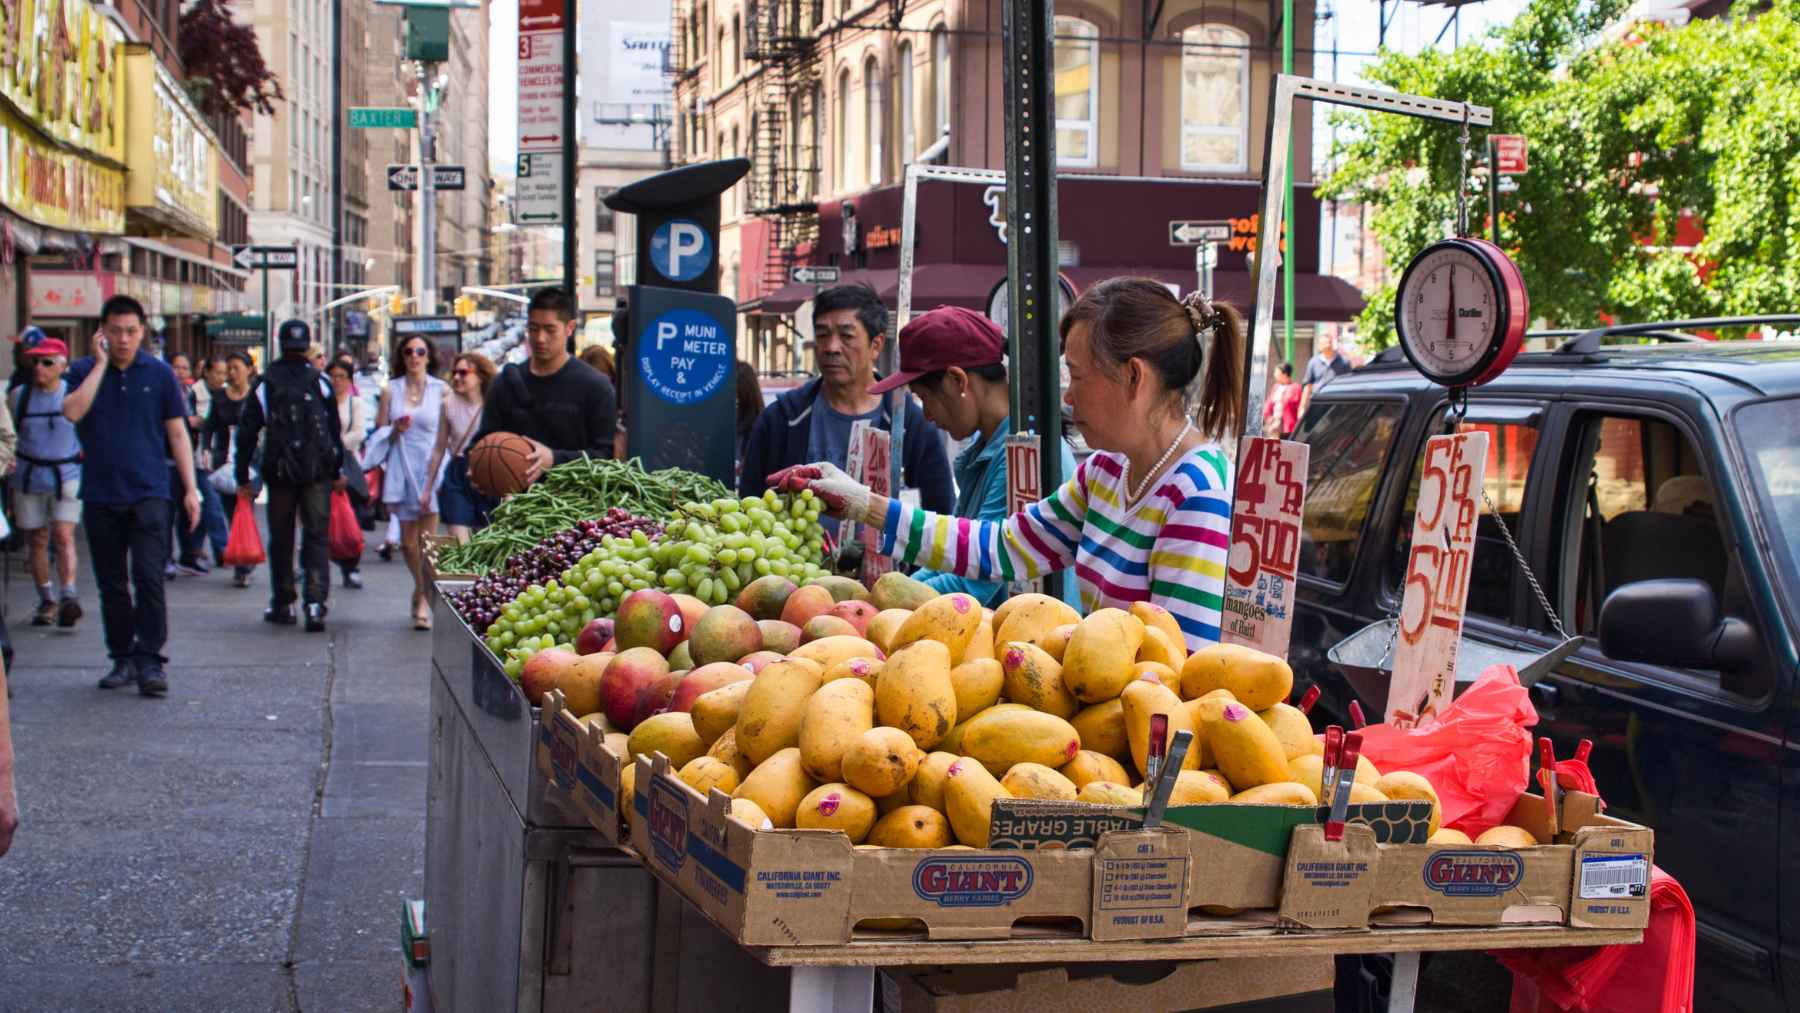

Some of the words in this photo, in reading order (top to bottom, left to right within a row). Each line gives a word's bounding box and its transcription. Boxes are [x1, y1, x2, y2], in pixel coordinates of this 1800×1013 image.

[519, 36, 530, 58] 3
[520, 63, 563, 74] COMMERCIA
[351, 109, 401, 126] BAXTER
[519, 154, 530, 176] 5
[434, 173, 457, 184] WAY
[668, 223, 703, 277] P
[656, 321, 678, 350] P
[684, 324, 717, 339] MUNI
[683, 340, 727, 355] METER
[670, 356, 695, 370] PAY
[676, 371, 686, 384] &
[703, 363, 726, 392] VEHICLE
[1237, 438, 1266, 514] 4
[1264, 439, 1303, 516] FOR
[1418, 439, 1450, 532] 5
[1450, 435, 1475, 543] FOR
[1225, 598, 1266, 621] mangoes
[992, 819, 1067, 836] GRAPES
[757, 871, 801, 881] CALIFORNIA
[803, 871, 826, 881] GIANT
[827, 871, 841, 881] INC.
[950, 863, 1020, 871] CALIFORNIA
[1430, 858, 1515, 883] GIANT
[921, 865, 1023, 892] GIANT
